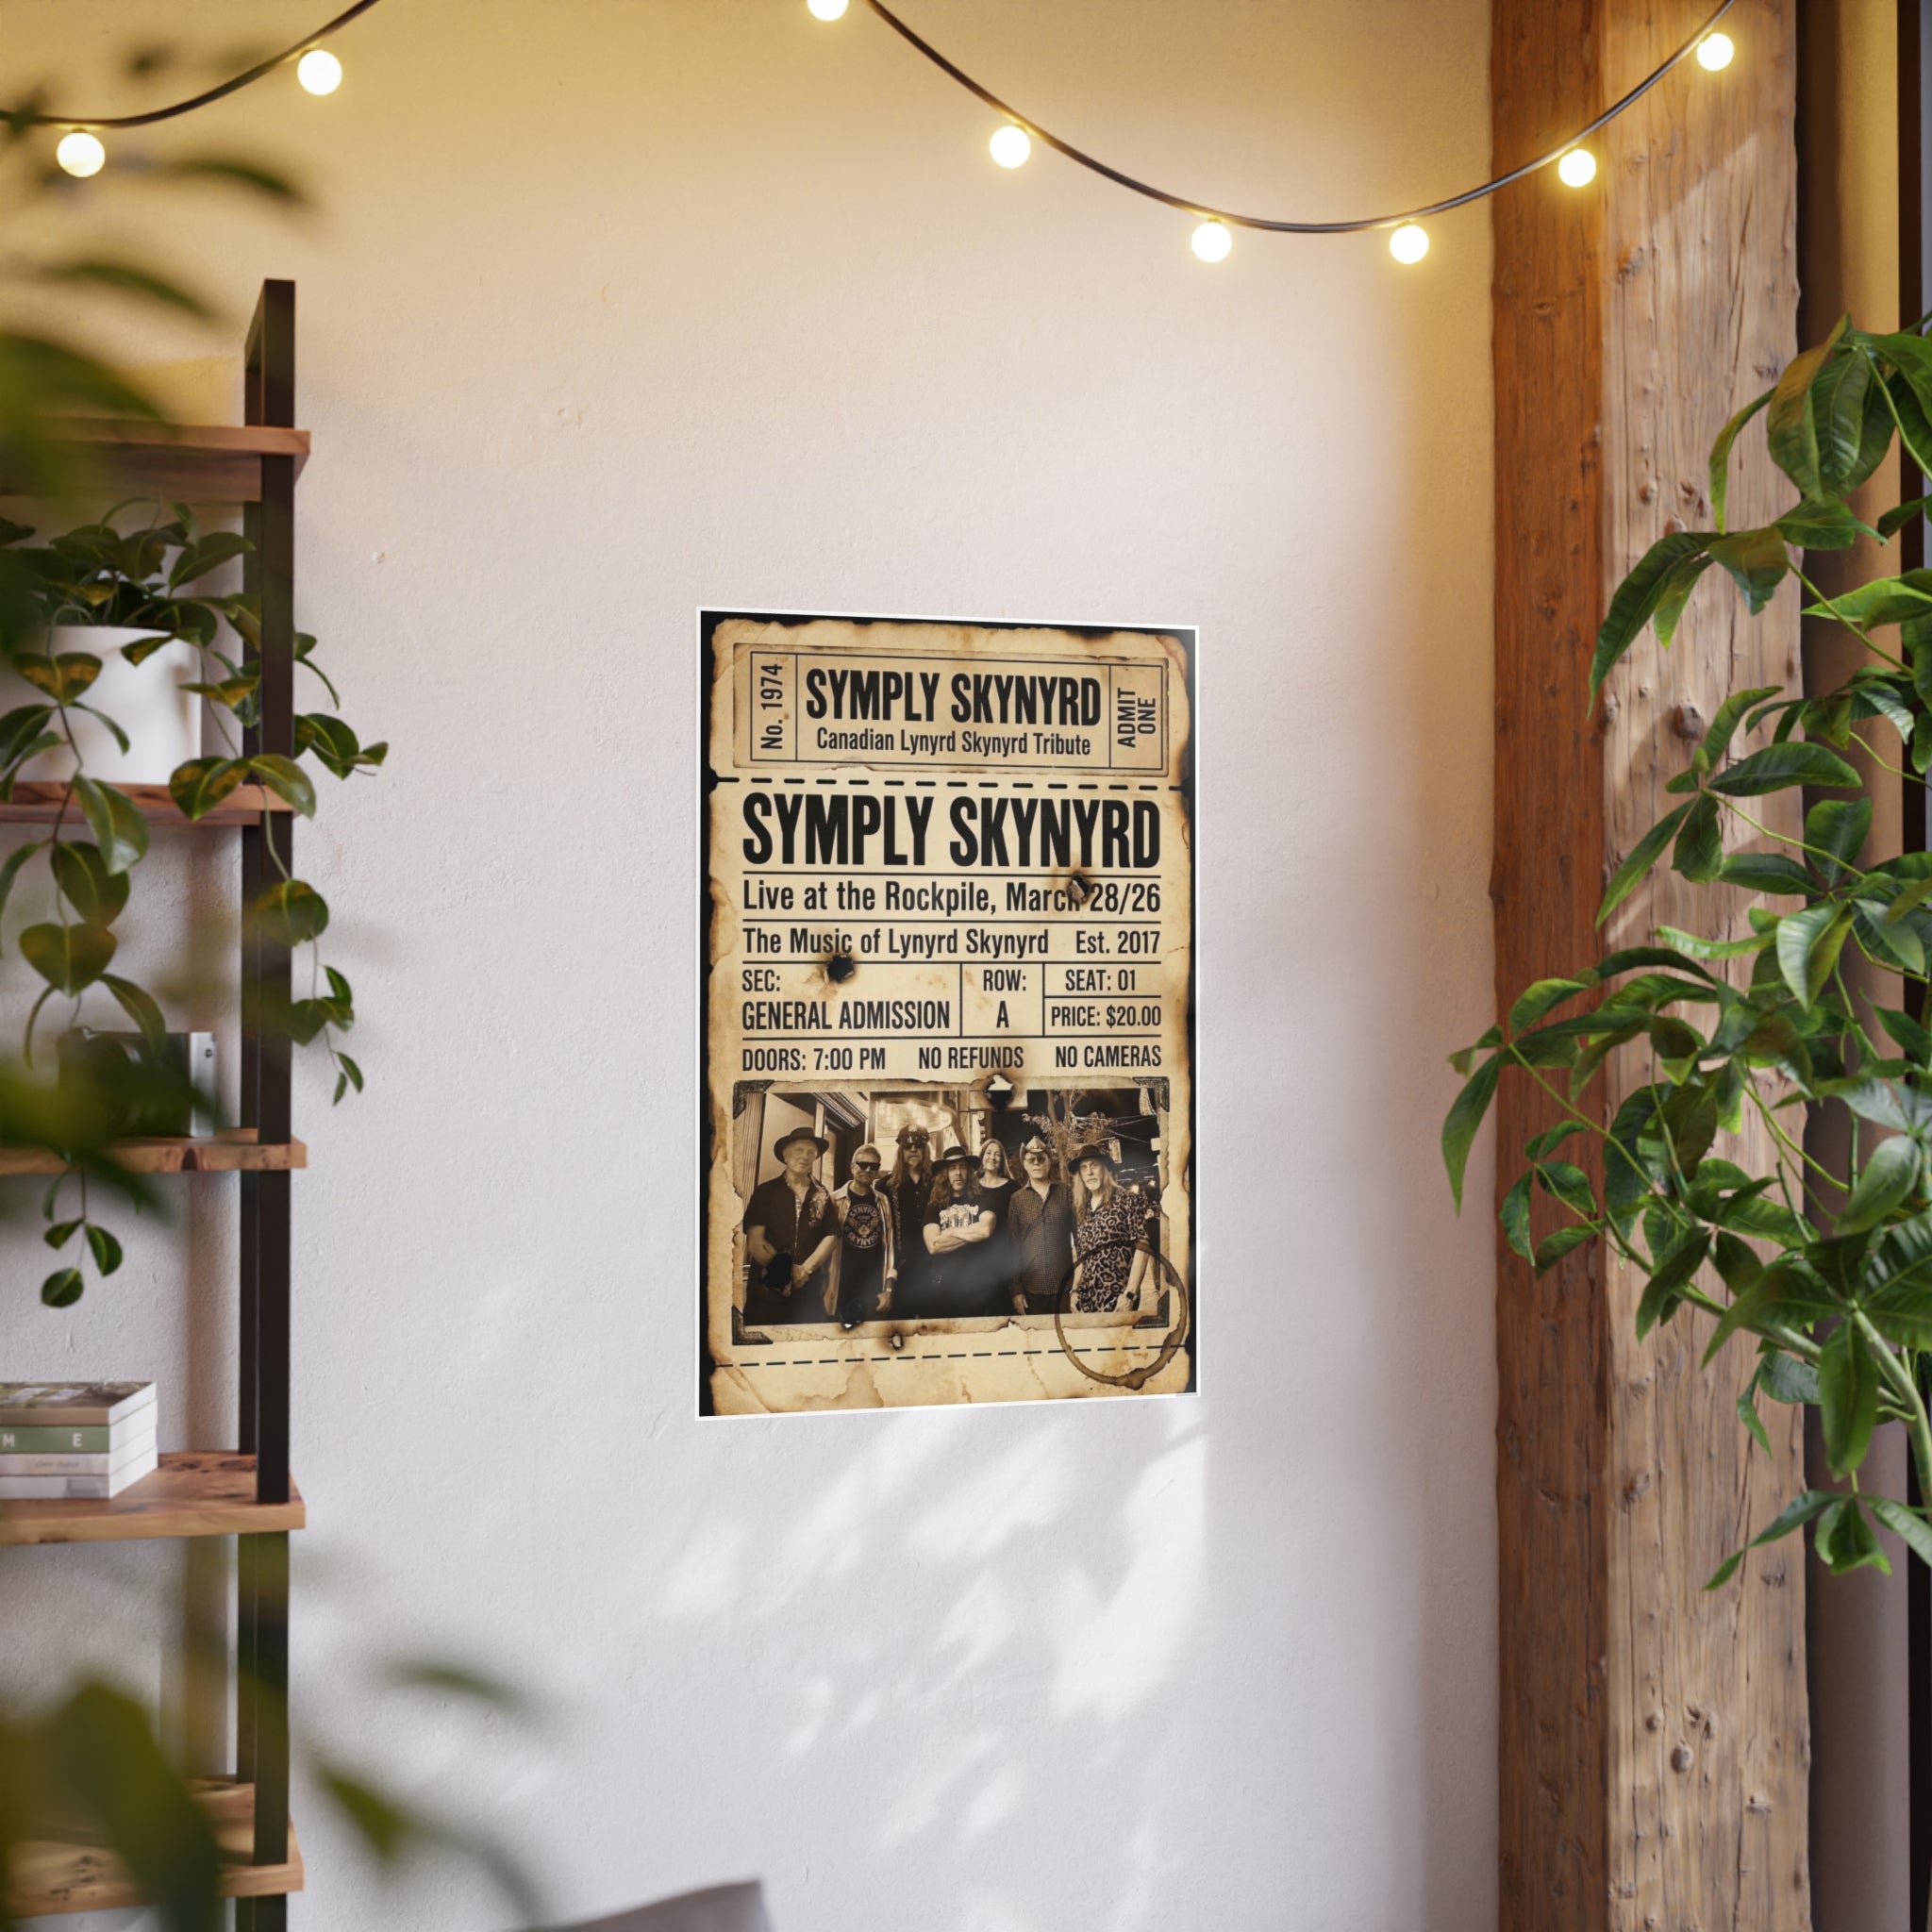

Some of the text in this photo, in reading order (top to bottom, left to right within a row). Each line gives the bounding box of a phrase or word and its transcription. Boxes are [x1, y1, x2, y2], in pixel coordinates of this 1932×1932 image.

[759, 663, 783, 750] No. 1974
[806, 668, 1101, 726] SYMPLY SKYNYRD
[1117, 687, 1136, 748] ADMIT
[1138, 697, 1157, 735] ONE
[817, 726, 1091, 758] Canadian Lynyrd Skynyrd Tribute
[742, 791, 1160, 869] SYMPLY SKYNYRD
[743, 879, 794, 910] Live
[804, 881, 827, 910] at
[836, 880, 875, 911] the
[886, 880, 996, 917] Rockpile,
[1089, 882, 1160, 915] 28/26
[742, 927, 1049, 959] The Music of Lynyrd Skynyrd
[1075, 930, 1160, 955] Est. 2017
[742, 969, 780, 992] SEC:
[983, 969, 1026, 991] ROW:
[1065, 969, 1136, 991] SEAT: 01
[741, 1000, 950, 1031] GENERAL ADMISSION
[996, 1001, 1009, 1028] A
[1051, 1004, 1161, 1029] PRICE: $20.00
[741, 1047, 886, 1072] DOORS: 7:00 PM
[919, 1045, 1024, 1070] NO REFUNDS
[1056, 1044, 1161, 1068] NO CAMERAS
